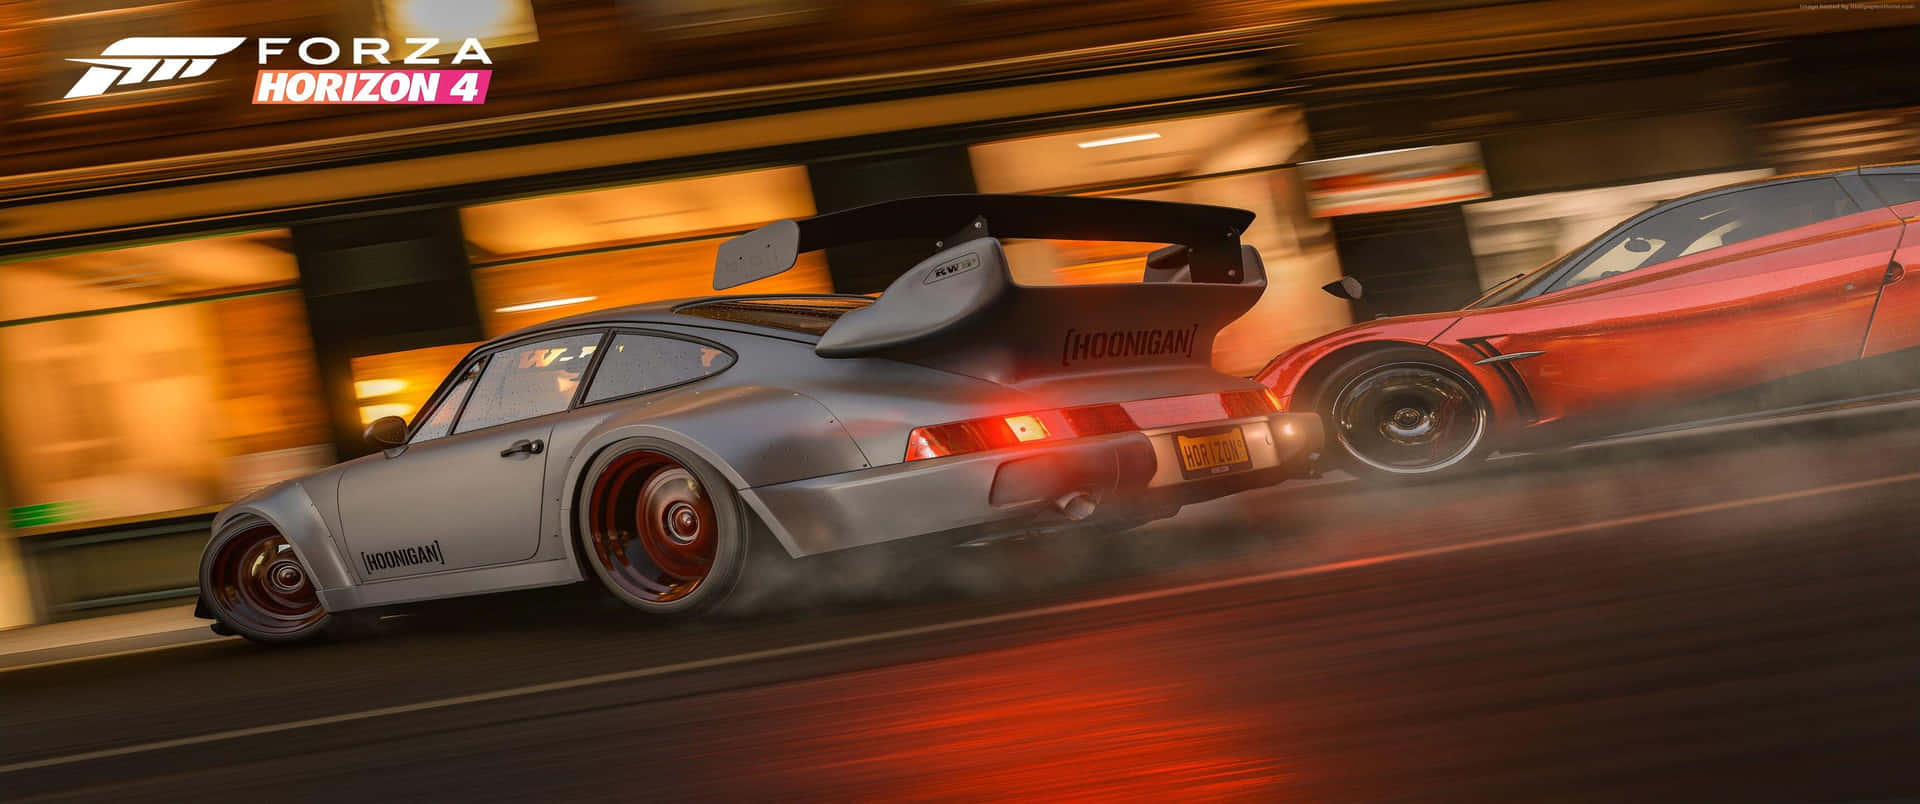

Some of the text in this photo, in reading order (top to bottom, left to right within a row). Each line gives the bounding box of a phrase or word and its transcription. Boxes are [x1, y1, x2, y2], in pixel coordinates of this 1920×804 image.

[1062, 323, 1199, 366] [HOONIGAN]
[1183, 439, 1240, 467] HORIZON
[361, 540, 445, 574] [HOONIGAN]
